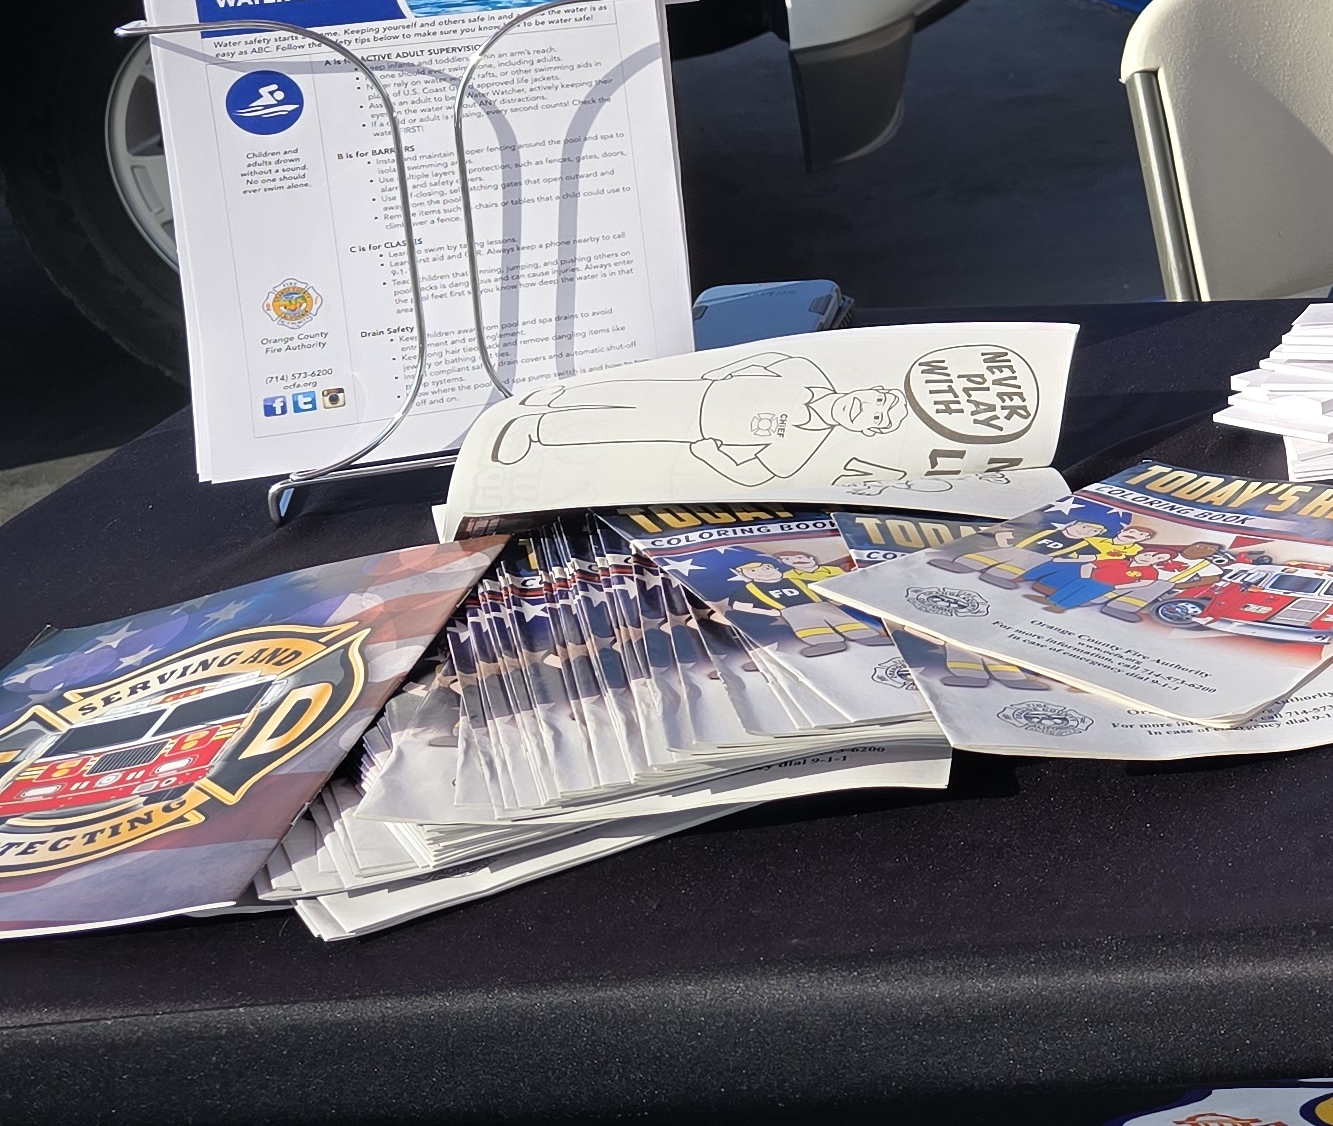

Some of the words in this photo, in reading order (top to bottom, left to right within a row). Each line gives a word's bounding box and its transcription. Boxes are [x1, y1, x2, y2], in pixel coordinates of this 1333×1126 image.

[246, 150, 281, 159] Children
[283, 147, 298, 155] and
[247, 160, 272, 168] adults
[274, 157, 300, 165] drown
[240, 169, 272, 177] without
[279, 173, 306, 182] should
[264, 184, 284, 192] swim
[260, 335, 294, 346] Orange
[297, 331, 329, 341] County
[265, 346, 282, 355] Fire
[284, 340, 327, 353] Authority
[265, 373, 289, 385] (714)
[291, 368, 333, 381] 573-6200
[283, 380, 317, 391] ocfa.org
[917, 359, 964, 415] WITH
[980, 351, 1032, 421] NEVER
[956, 373, 1004, 432] PLAY
[777, 413, 788, 438] CHIEF
[1128, 464, 1310, 512] TODAY'S
[1095, 483, 1191, 516] COLORING
[1193, 510, 1251, 526] BOOK
[650, 526, 771, 548] COLORING
[1036, 538, 1063, 549] FD
[770, 588, 799, 599] FD
[992, 620, 1014, 631] For
[1014, 629, 1045, 640] more
[1117, 661, 1142, 671] call
[1140, 669, 1218, 694] 714-573-6200
[1030, 619, 1076, 637] Orange
[1077, 634, 1123, 652] County
[1124, 647, 1151, 661] Fire
[1150, 658, 1214, 679] Authority
[1007, 633, 1020, 641] In
[1018, 639, 1048, 649] case
[1048, 645, 1063, 653] of
[1062, 650, 1124, 674] emergency
[1125, 671, 1152, 682] dial
[1150, 679, 1182, 692] 9-1-1
[77, 652, 240, 717] SERVING
[240, 647, 304, 667] AND
[237, 682, 333, 761] D
[811, 755, 847, 764] 9-1-1
[0, 797, 188, 857] TECTING
